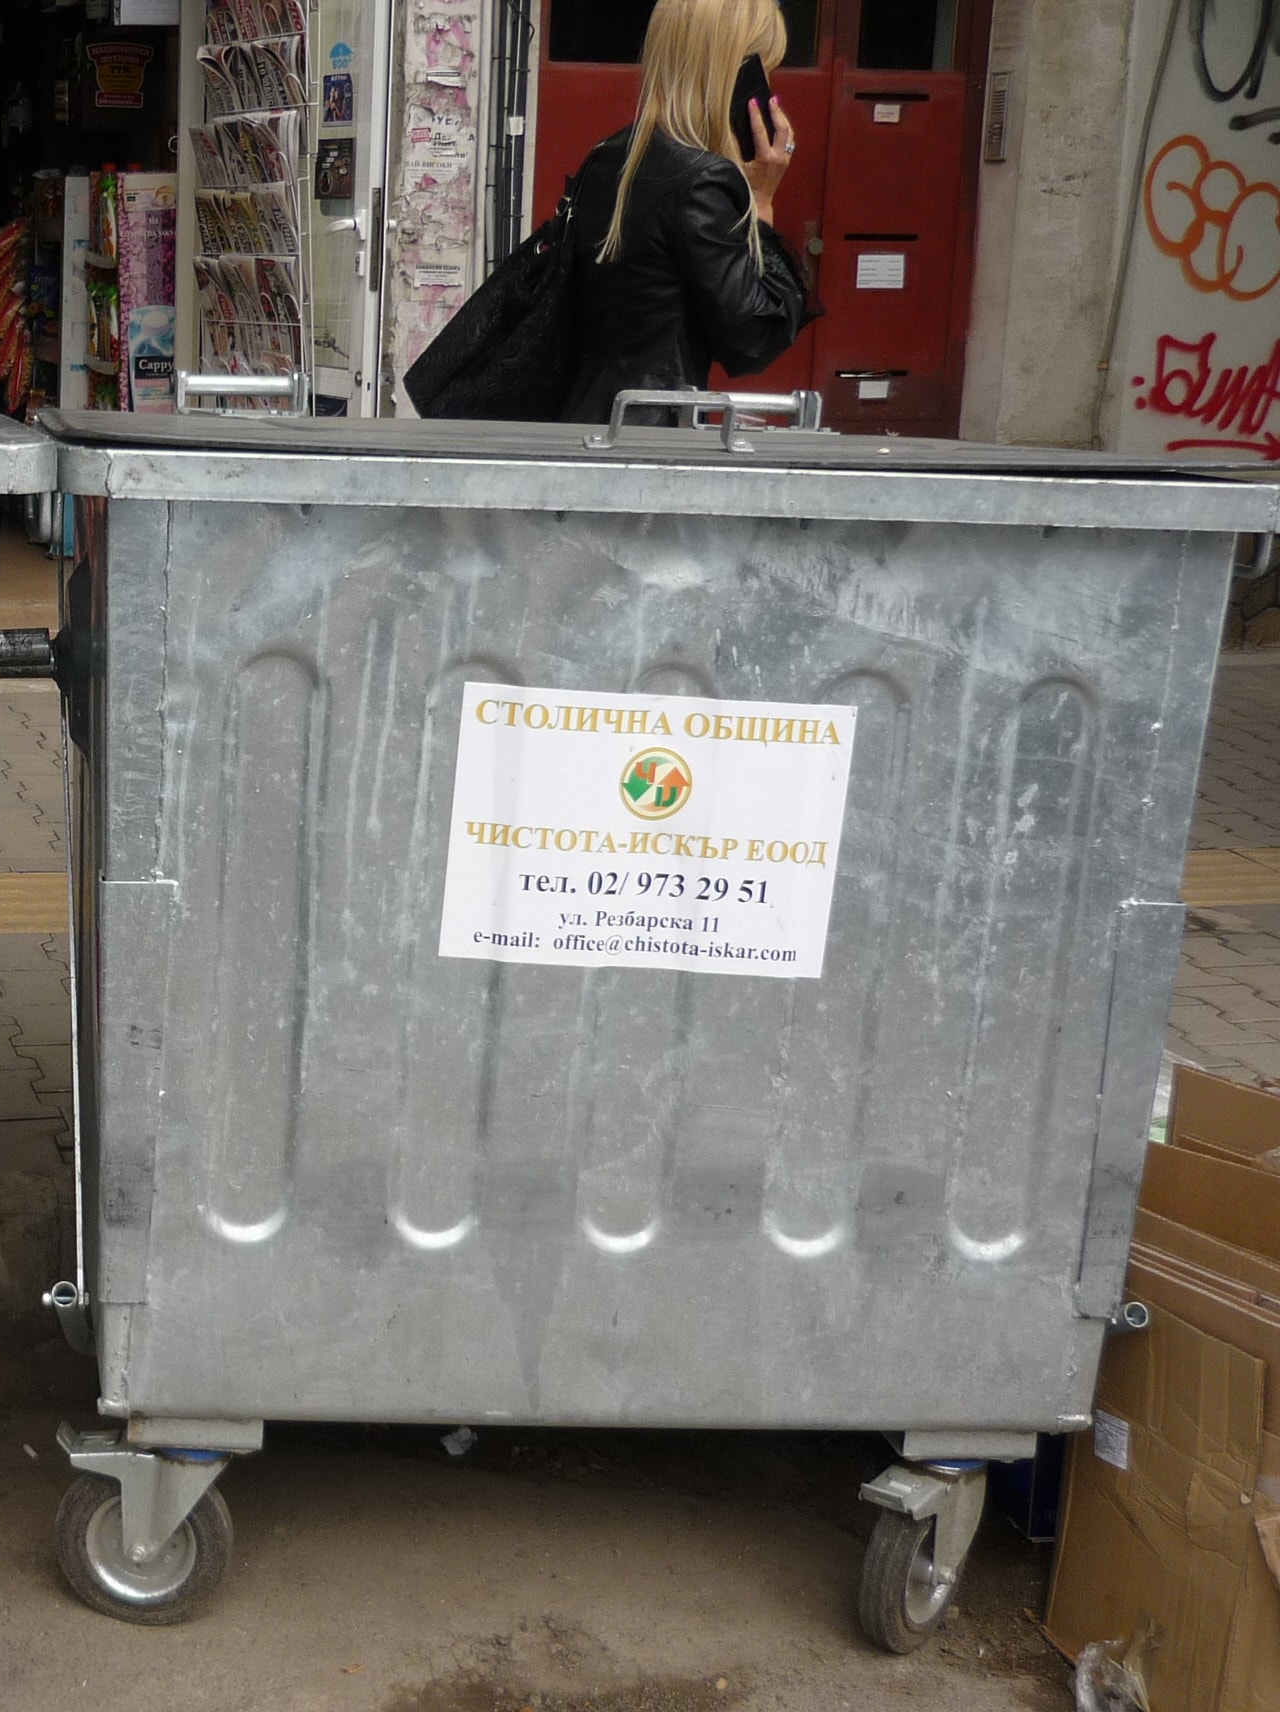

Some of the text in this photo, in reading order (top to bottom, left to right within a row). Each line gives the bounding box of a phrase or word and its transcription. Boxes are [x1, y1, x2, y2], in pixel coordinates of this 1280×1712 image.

[475, 699, 841, 747] СТОЛИЧНА ОБЩИНА
[466, 821, 827, 867] ЧИСТОТА-ИСКЪР ЕООД
[519, 871, 769, 904] тел. 02/ 973 29 51
[558, 910, 719, 933] ул. Резбарска 11
[473, 931, 797, 962] e-mail: office@chistota-iskar.com
